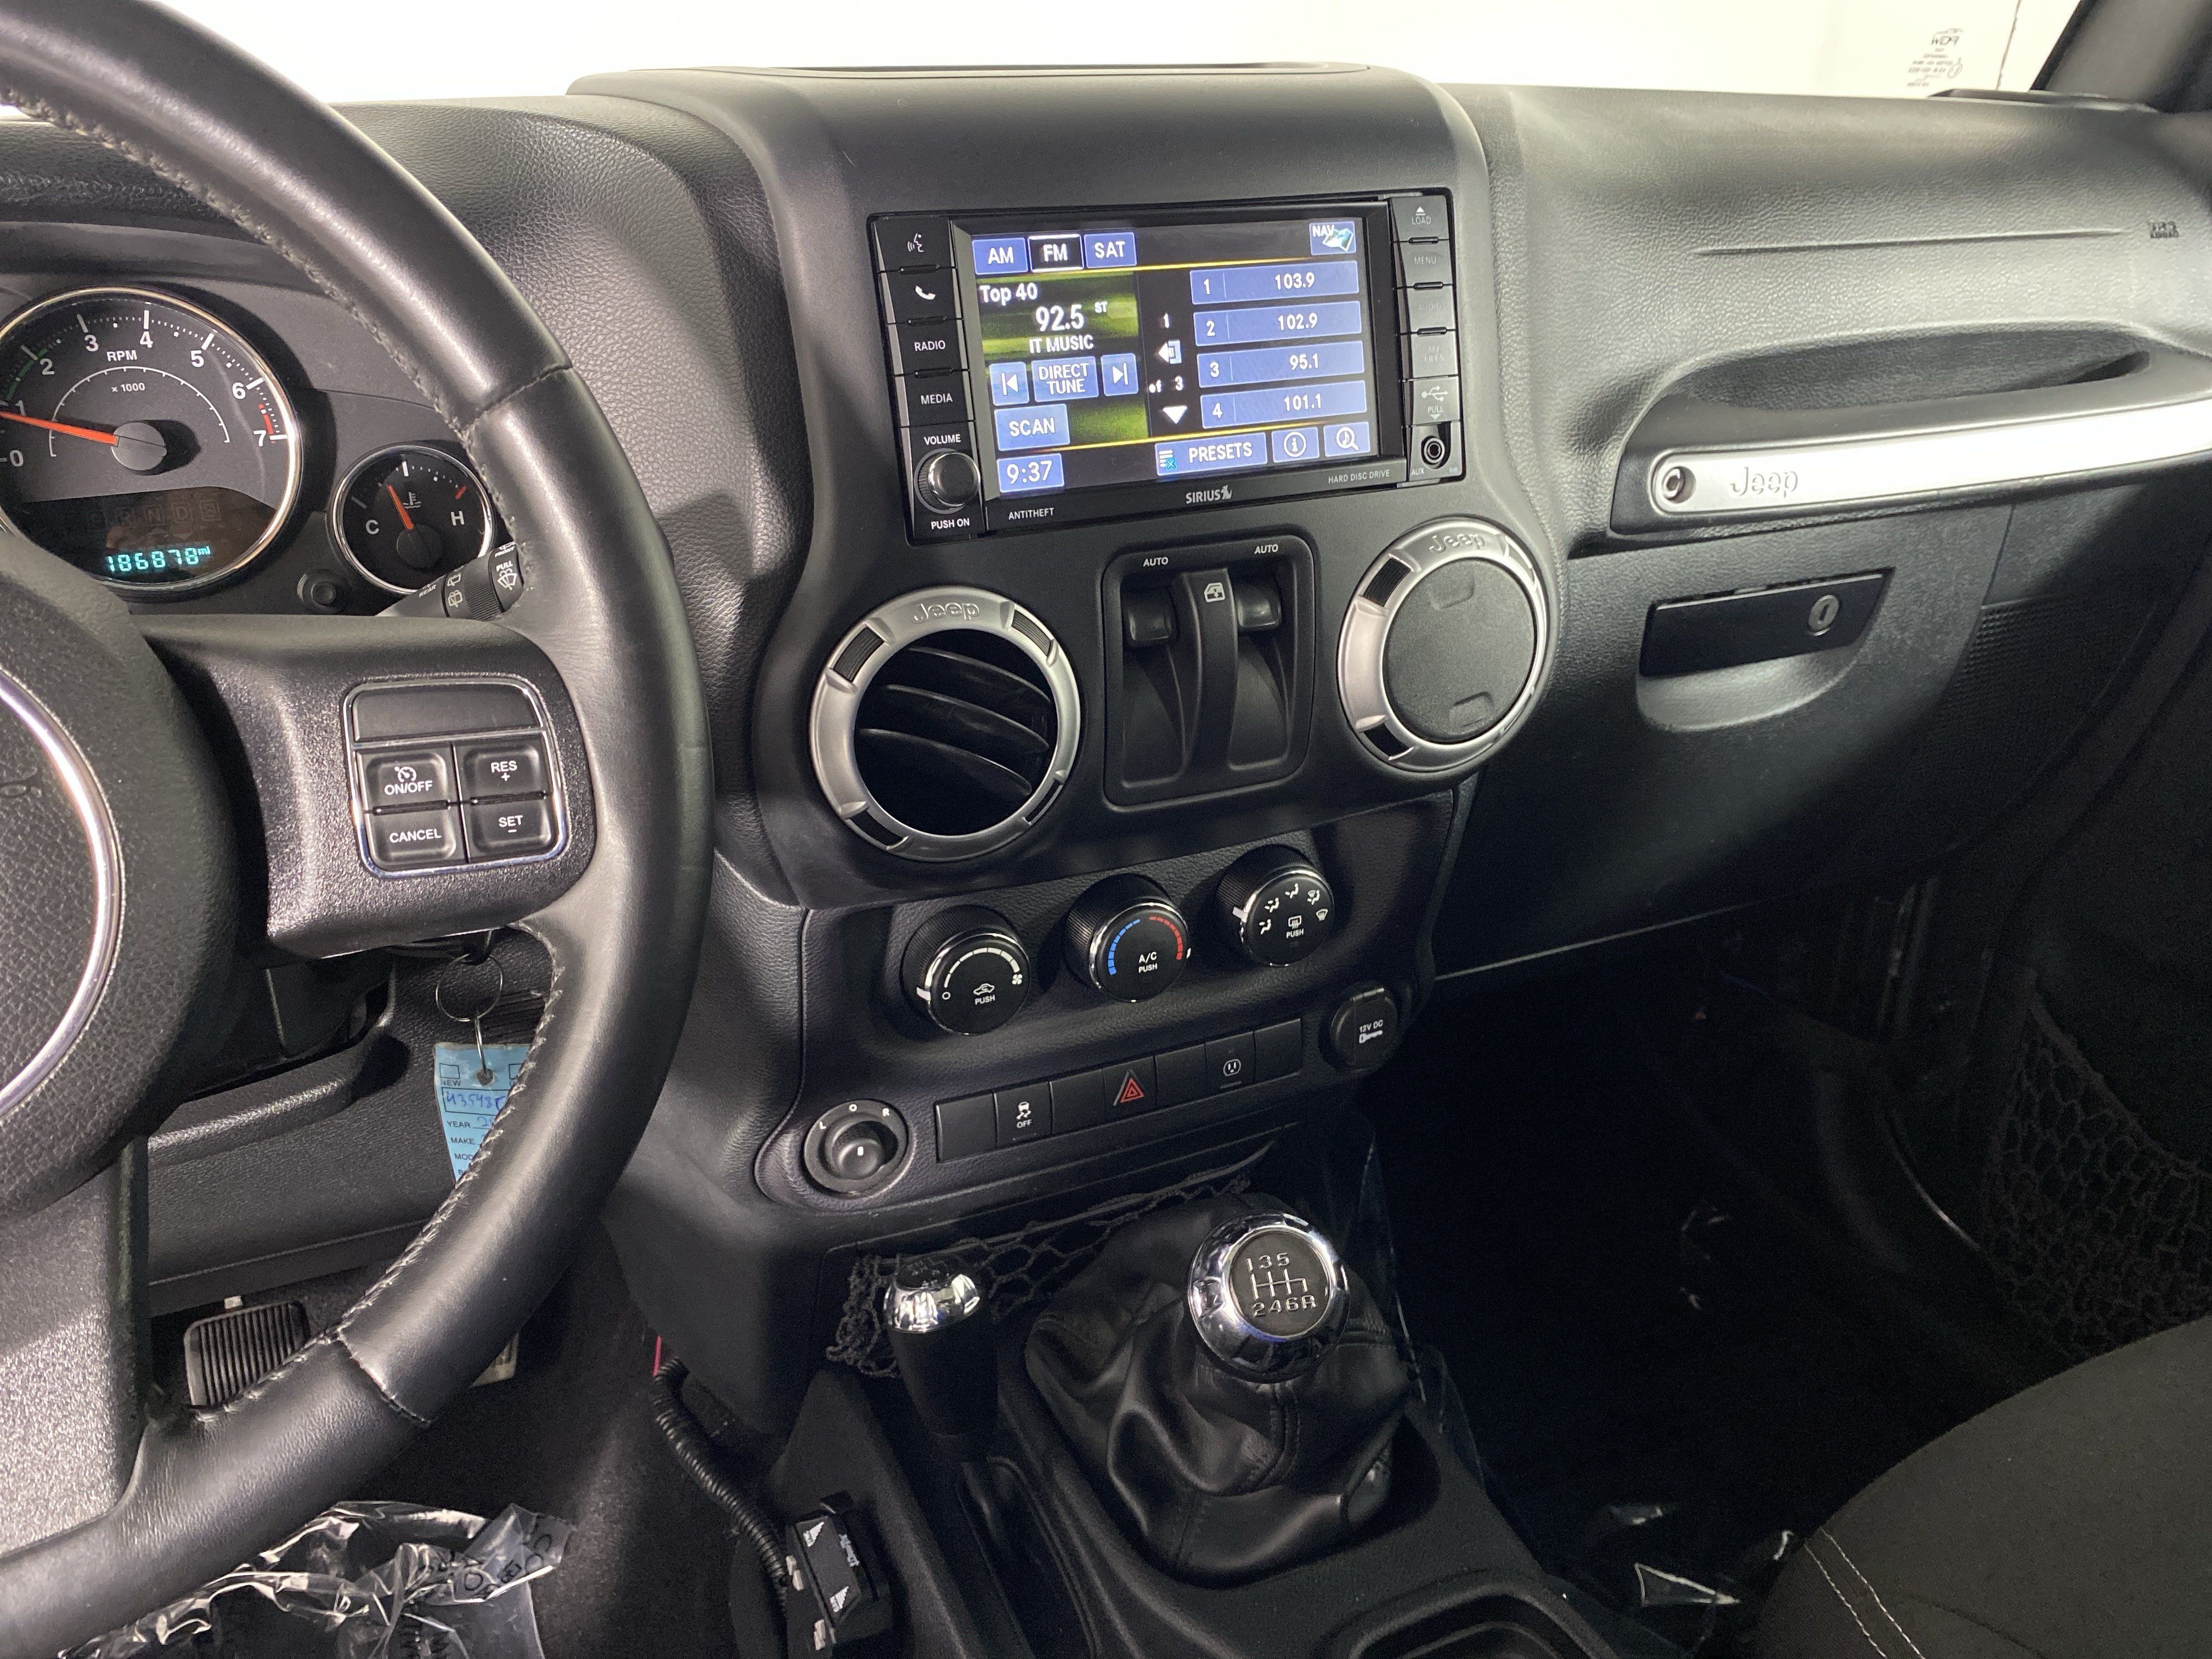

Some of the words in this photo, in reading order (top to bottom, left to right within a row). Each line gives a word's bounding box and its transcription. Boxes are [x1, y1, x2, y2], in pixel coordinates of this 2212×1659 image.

[1412, 216, 1432, 225] LOAD
[1312, 225, 1335, 237] NAV
[988, 247, 1014, 265] AM
[1043, 244, 1068, 262] FM
[1094, 241, 1126, 258] SAT
[1414, 256, 1437, 265] MENU
[1203, 279, 1211, 295] 1
[1274, 272, 1316, 290] 103.9
[980, 284, 1012, 304] Top
[1015, 282, 1038, 300] 40
[1035, 304, 1085, 331] 92.5
[1094, 301, 1108, 314] ST
[1163, 313, 1170, 328] 1
[1206, 320, 1216, 337] 2
[1277, 313, 1318, 331] 102.9
[84, 334, 99, 352] 3
[139, 331, 154, 348] 4
[913, 340, 946, 352] RADIO
[1029, 338, 1042, 354] IT
[1046, 335, 1094, 353] MUSIC
[106, 350, 138, 362] RPM
[190, 350, 205, 368] 5
[41, 358, 55, 375] 2
[1039, 363, 1090, 381] DIRECT
[1210, 362, 1220, 378] 3
[1289, 353, 1320, 370] 95.1
[120, 382, 145, 393] 1000
[232, 382, 246, 399] 6
[1046, 379, 1086, 395] TUNE
[1175, 376, 1184, 391] 3
[921, 393, 953, 405] MEDIA
[1211, 403, 1223, 419] 4
[1283, 393, 1323, 411] 101.1
[15, 401, 26, 416] 1
[1427, 405, 1444, 414] PULL
[1009, 418, 1056, 437] SCAN
[253, 430, 267, 447] 7
[923, 434, 962, 445] VOLUME
[9, 449, 24, 467] 0
[1188, 442, 1253, 464] PRESETS
[1006, 460, 1053, 484] 9:37
[1328, 472, 1350, 484] HARD
[1350, 471, 1368, 483] DISC
[1369, 469, 1390, 480] DRIVE
[1410, 467, 1425, 476] AUX
[1730, 466, 1799, 499] Jeep
[1185, 488, 1223, 504] SIRIUS
[450, 510, 465, 526] H
[1008, 507, 1055, 521] ANTITHEFT
[365, 520, 380, 535] C
[930, 518, 955, 531] PUSH
[956, 518, 970, 529] ON
[1254, 544, 1279, 555] AUTO
[1428, 533, 1485, 554] Jeep
[494, 546, 516, 558] FRONT
[106, 547, 199, 573] 186878
[495, 560, 514, 572] PULL
[1143, 555, 1169, 568] AUTO
[419, 584, 437, 599] REAR
[910, 602, 980, 624] Jeep
[490, 760, 518, 774] RES
[383, 780, 433, 796] ON/OFF
[498, 815, 524, 828] SET
[389, 828, 442, 844] CANCEL
[1285, 928, 1304, 939] PUSH
[1138, 951, 1158, 964] A/C
[1138, 963, 1158, 974] PUSH
[974, 994, 996, 1005] PUSH
[1359, 1023, 1372, 1034] 12V
[1373, 1019, 1384, 1029] DC
[882, 1107, 890, 1117] R
[819, 1121, 827, 1130] L
[1016, 1119, 1032, 1128] OFF
